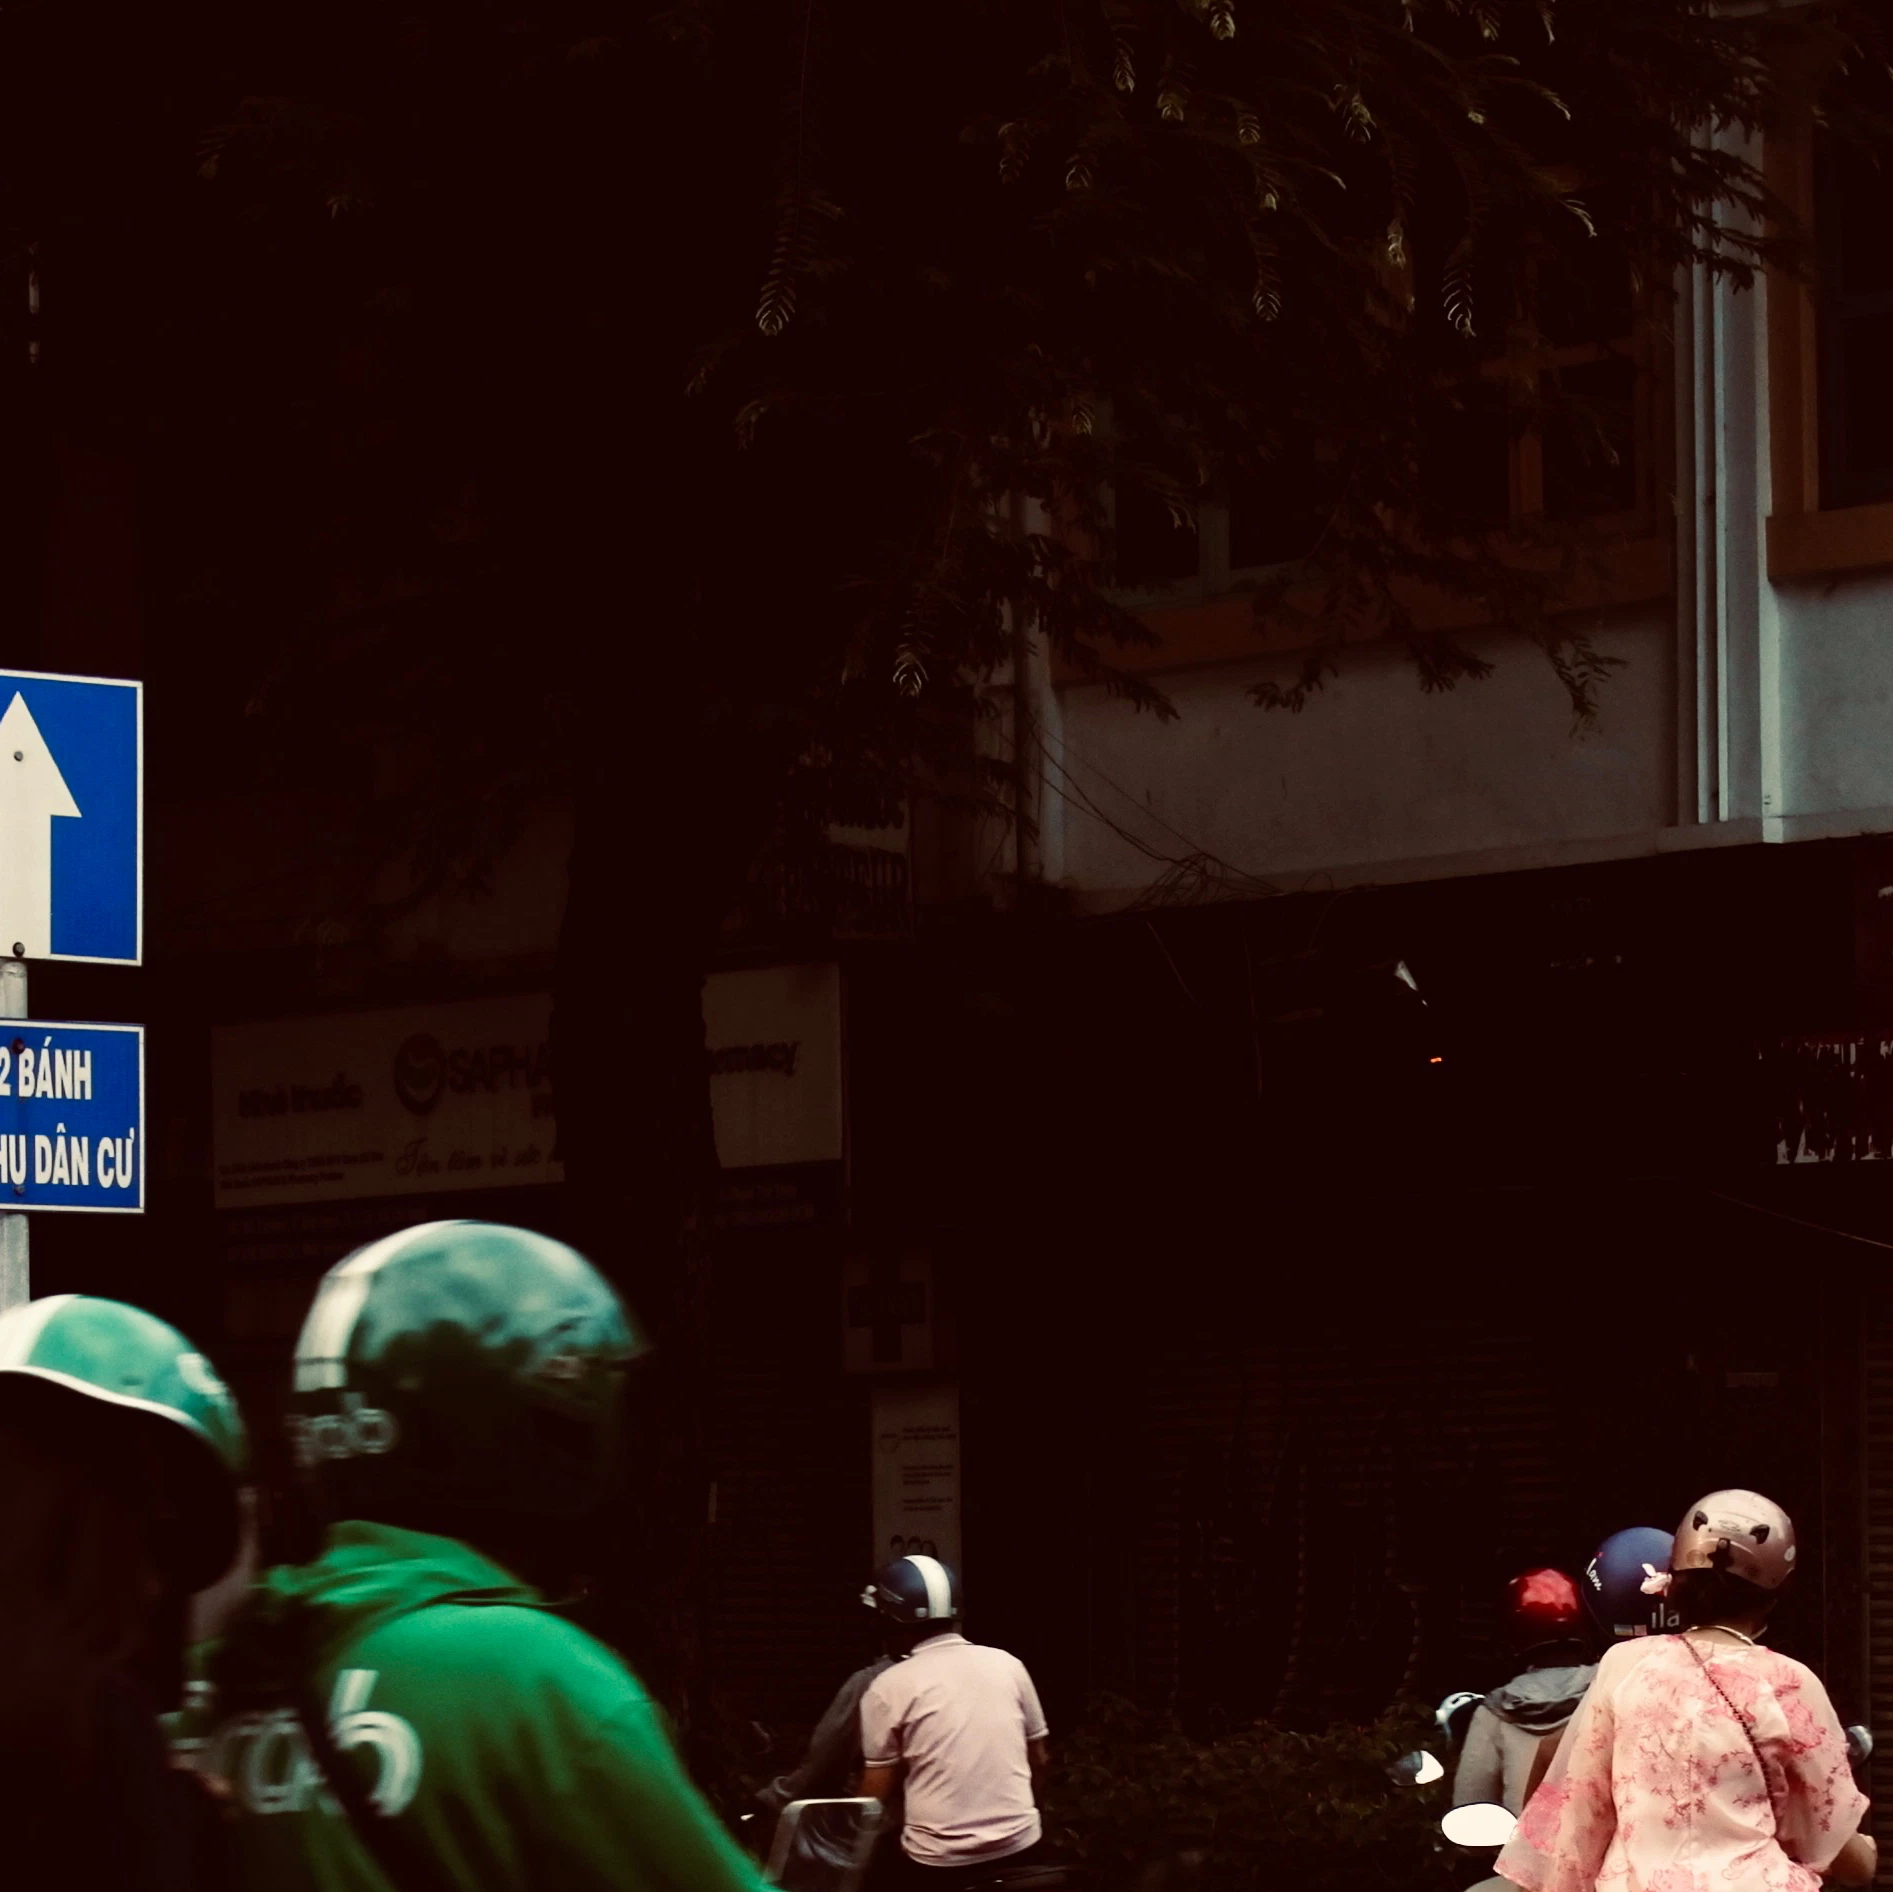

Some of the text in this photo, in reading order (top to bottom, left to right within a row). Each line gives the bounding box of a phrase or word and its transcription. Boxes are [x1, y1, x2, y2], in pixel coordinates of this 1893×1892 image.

[18, 1036, 92, 1100] BÁNH
[34, 1122, 89, 1186] DÂN
[96, 1127, 135, 1189] CƯ
